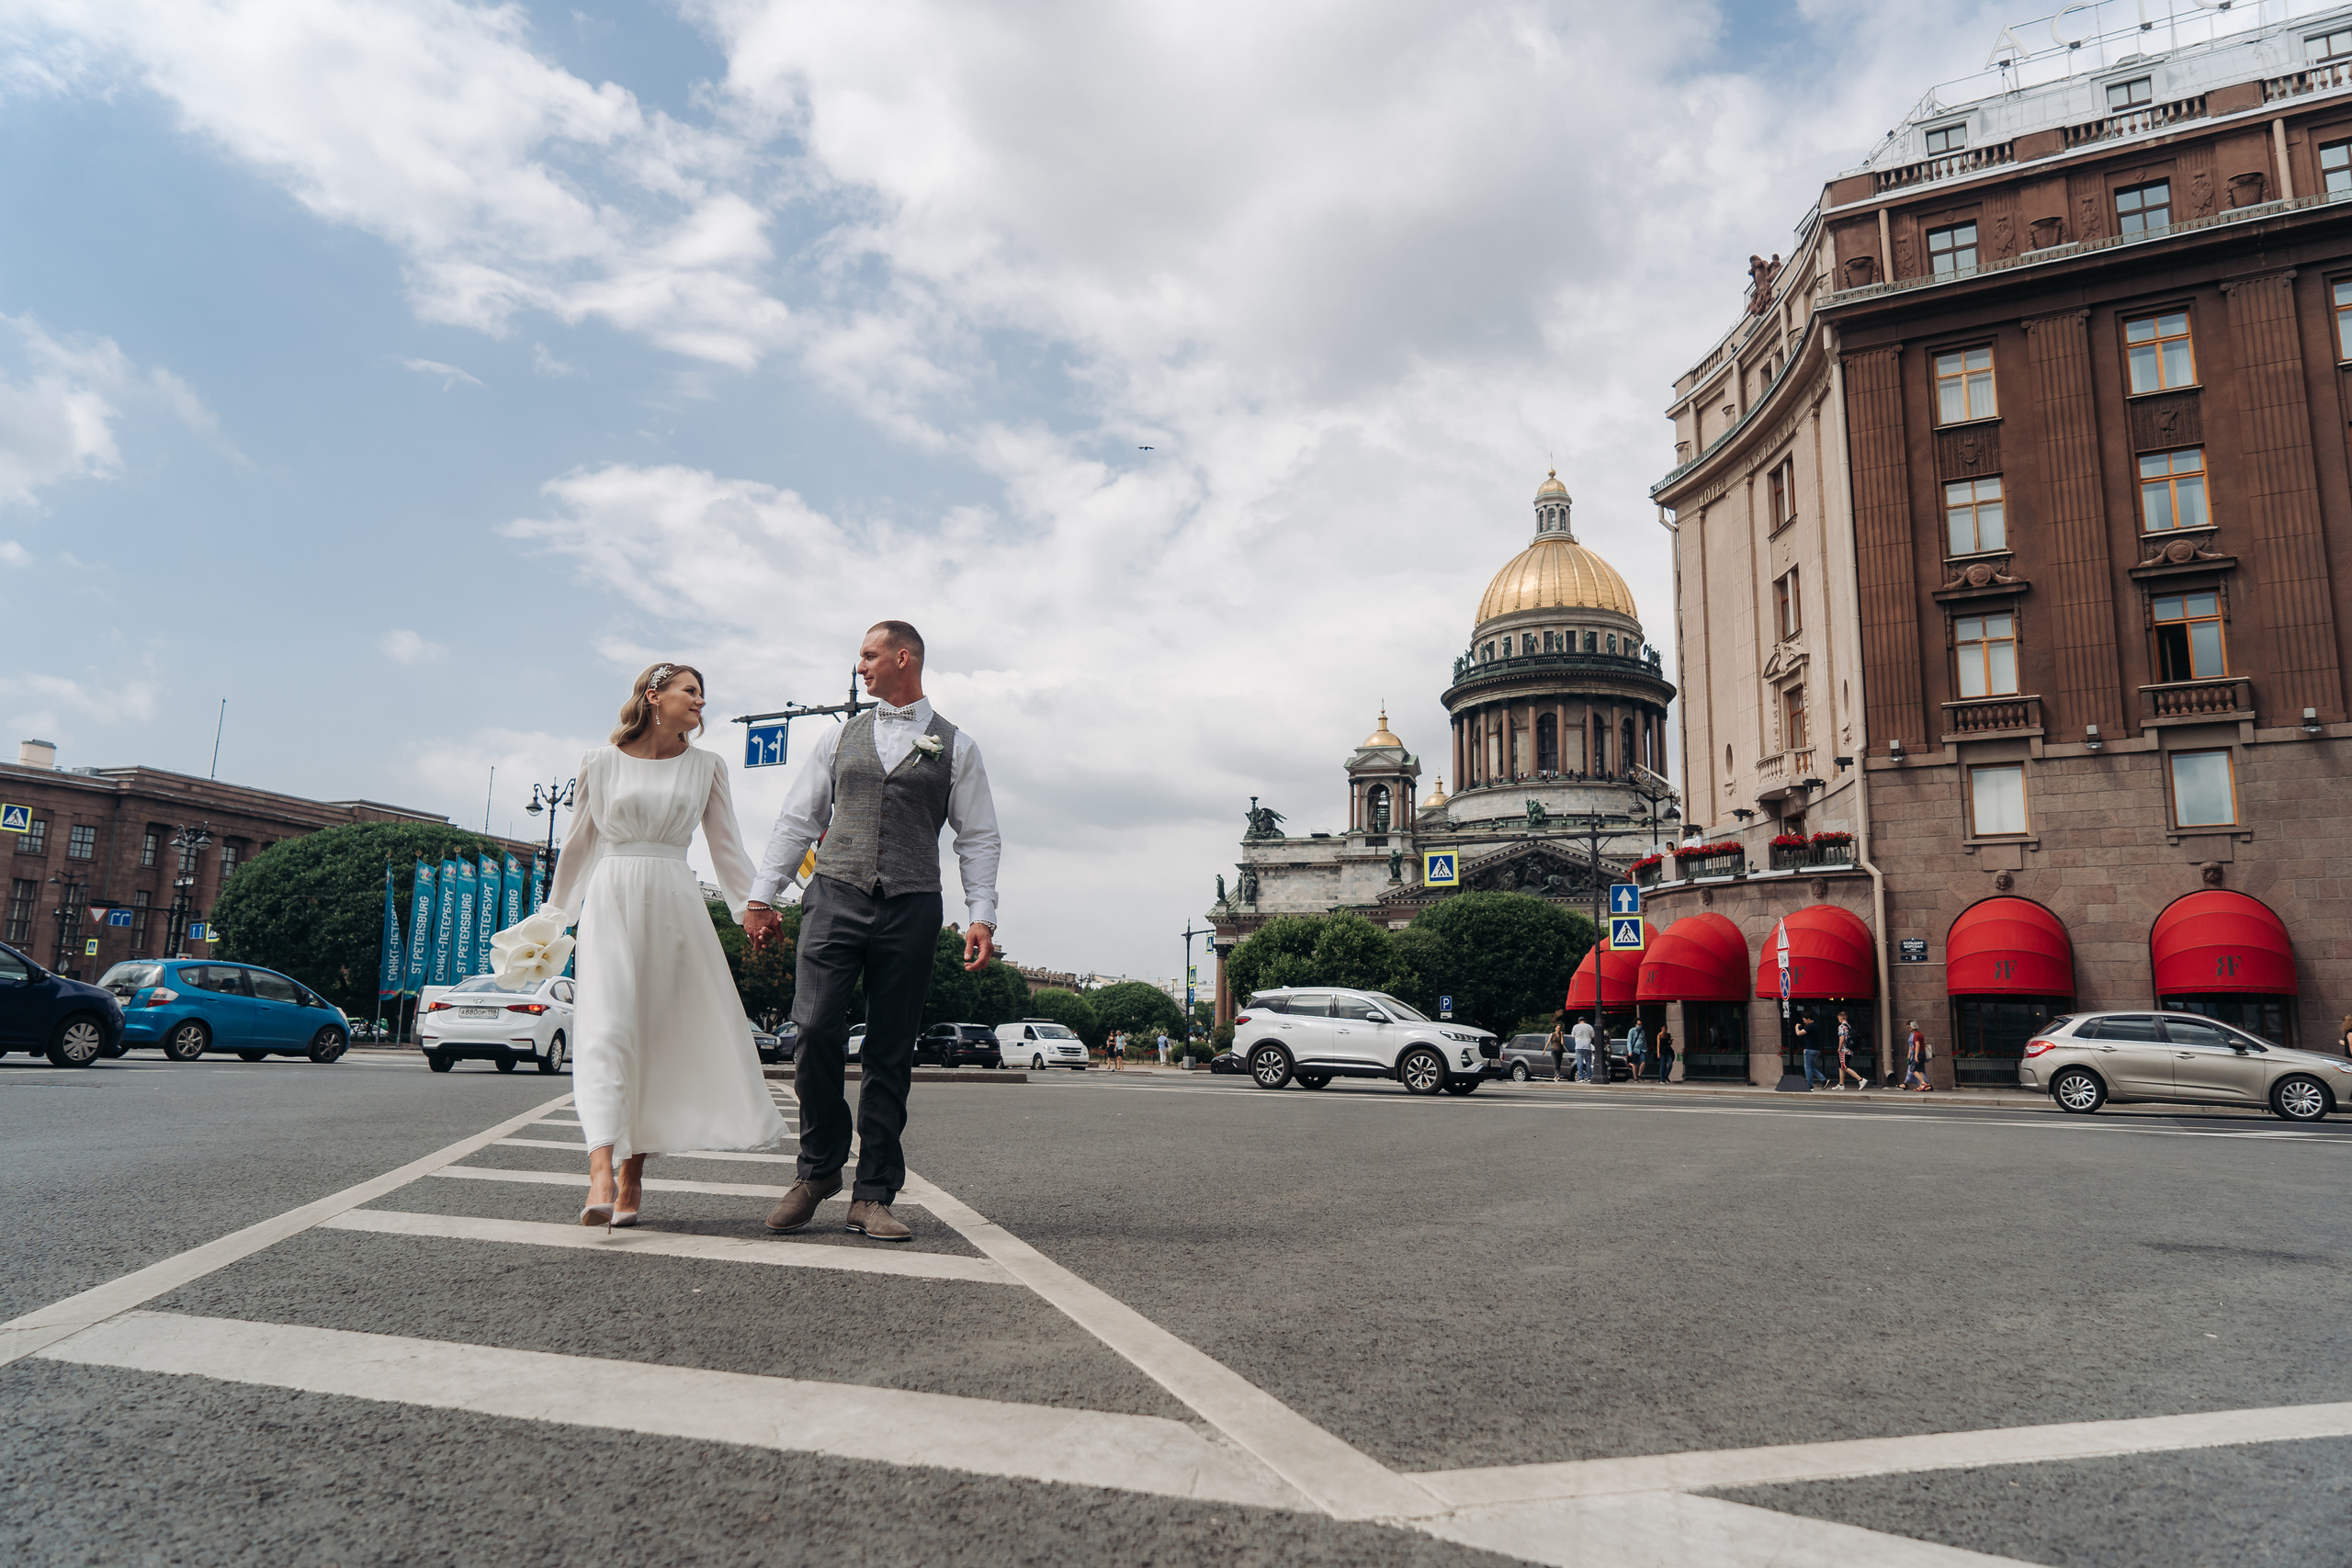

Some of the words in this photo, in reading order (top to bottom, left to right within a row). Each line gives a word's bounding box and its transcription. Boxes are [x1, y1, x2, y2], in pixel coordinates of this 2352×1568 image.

[413, 896, 430, 960] PETERSBURG
[435, 886, 454, 981] САНКТ-ПЕТЕРБУРГ
[458, 892, 472, 959] PETERSBURG
[478, 883, 493, 974] АНКТ-ПЕТЕРБУРГ
[412, 961, 423, 974] ST
[457, 960, 467, 974] ST
[1442, 998, 1450, 1010] P
